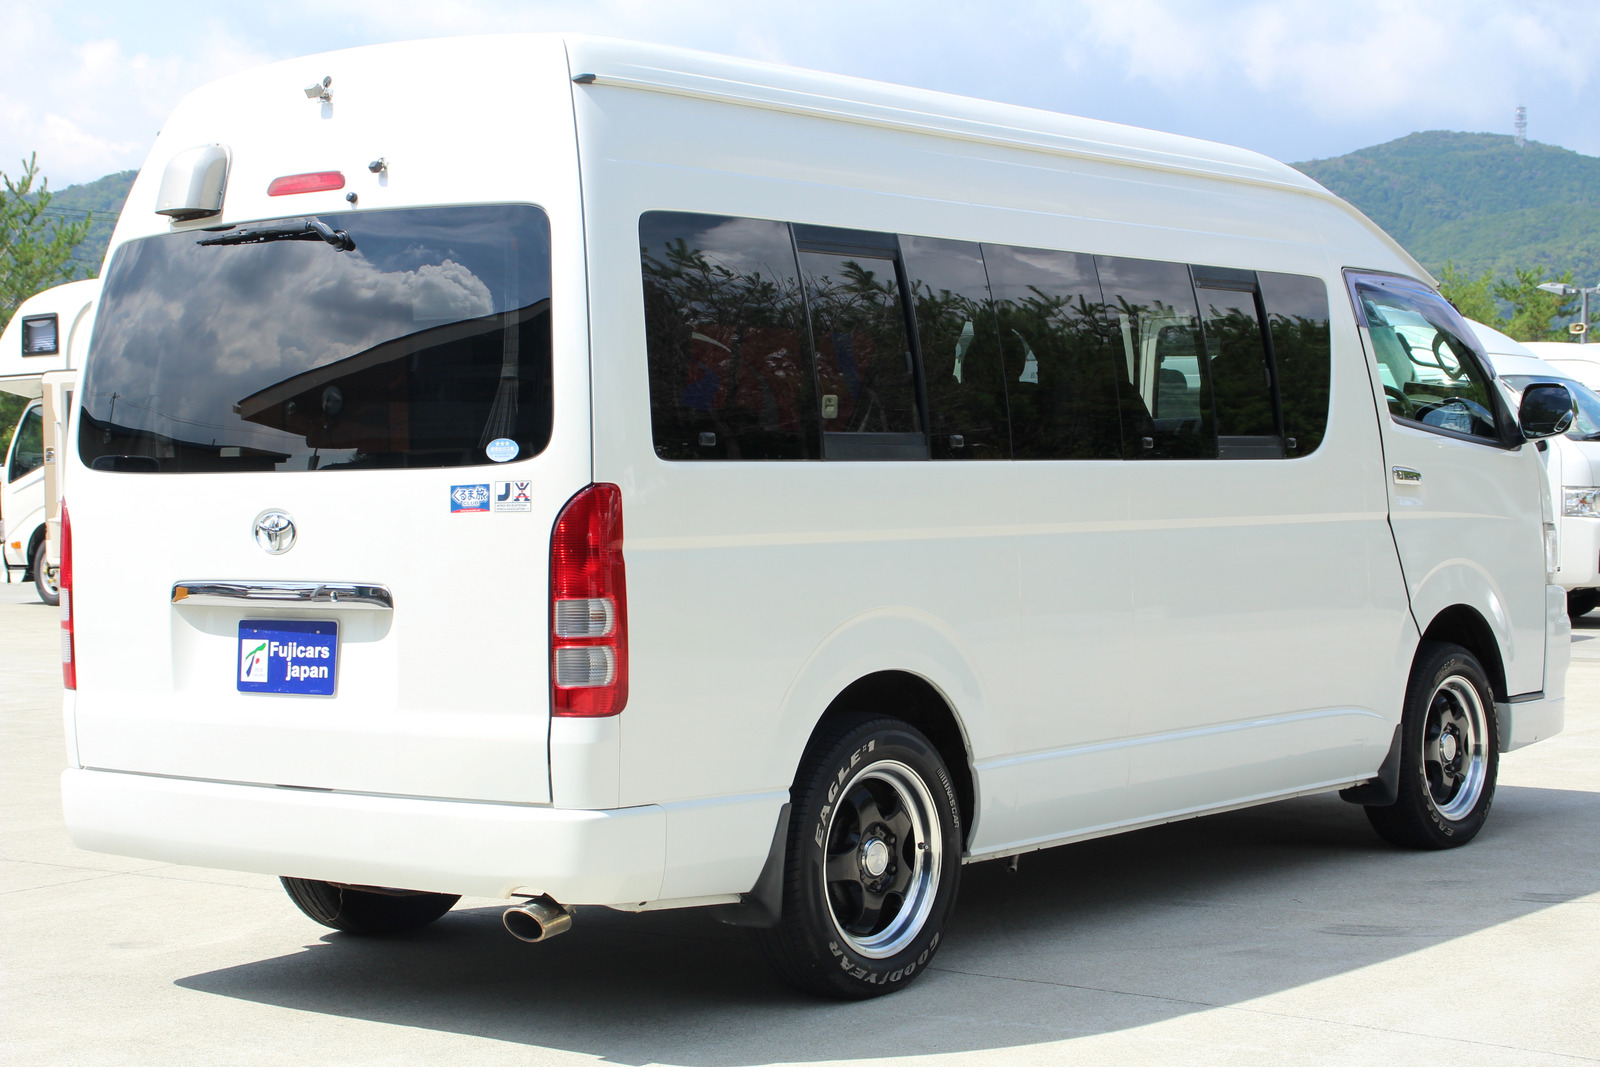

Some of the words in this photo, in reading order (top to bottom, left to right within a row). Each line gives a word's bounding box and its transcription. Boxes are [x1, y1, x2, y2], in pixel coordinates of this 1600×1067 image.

[452, 486, 489, 502] くるま旅
[269, 641, 331, 662] Fujicars
[284, 661, 329, 682] japan
[945, 786, 961, 829] NASCAR
[828, 931, 940, 985] GOODYEAR
